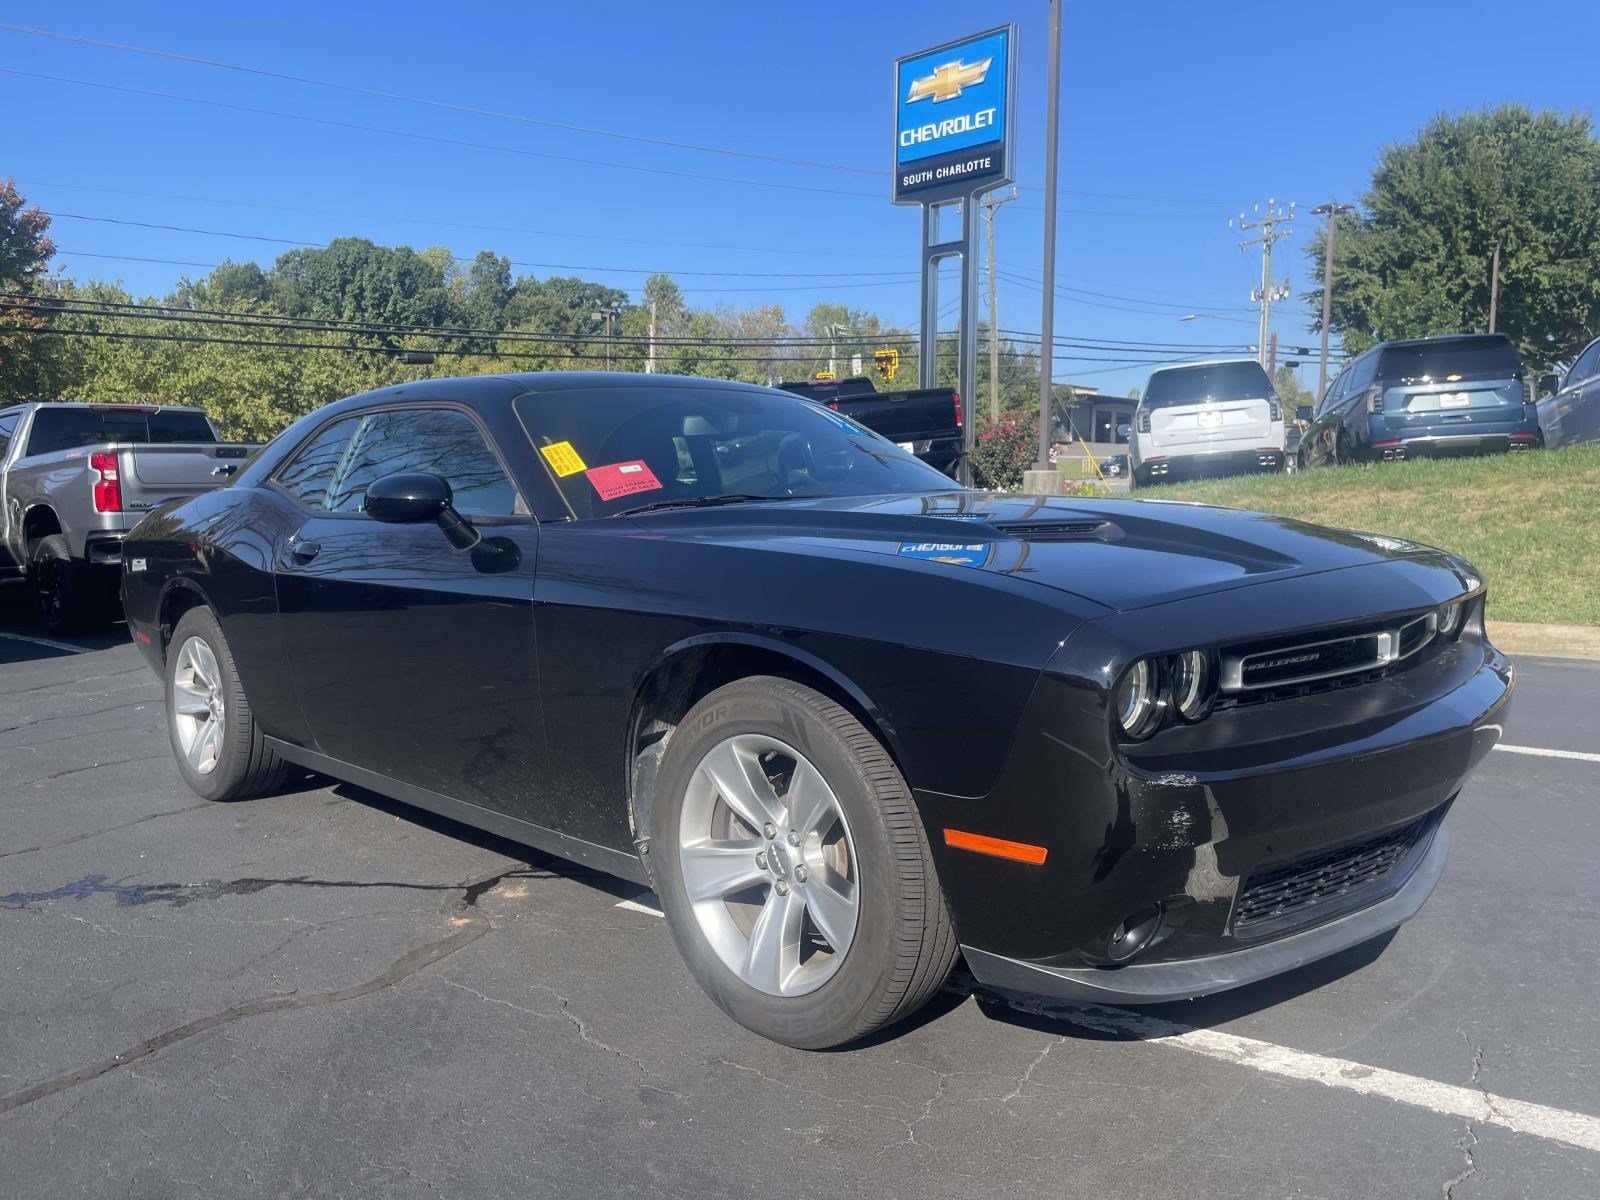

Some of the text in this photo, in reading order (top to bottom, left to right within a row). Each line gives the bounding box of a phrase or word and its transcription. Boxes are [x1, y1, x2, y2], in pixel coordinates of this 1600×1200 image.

[900, 108, 996, 146] CHEVROLET
[903, 157, 991, 186] SOUTH CHARLOTTE
